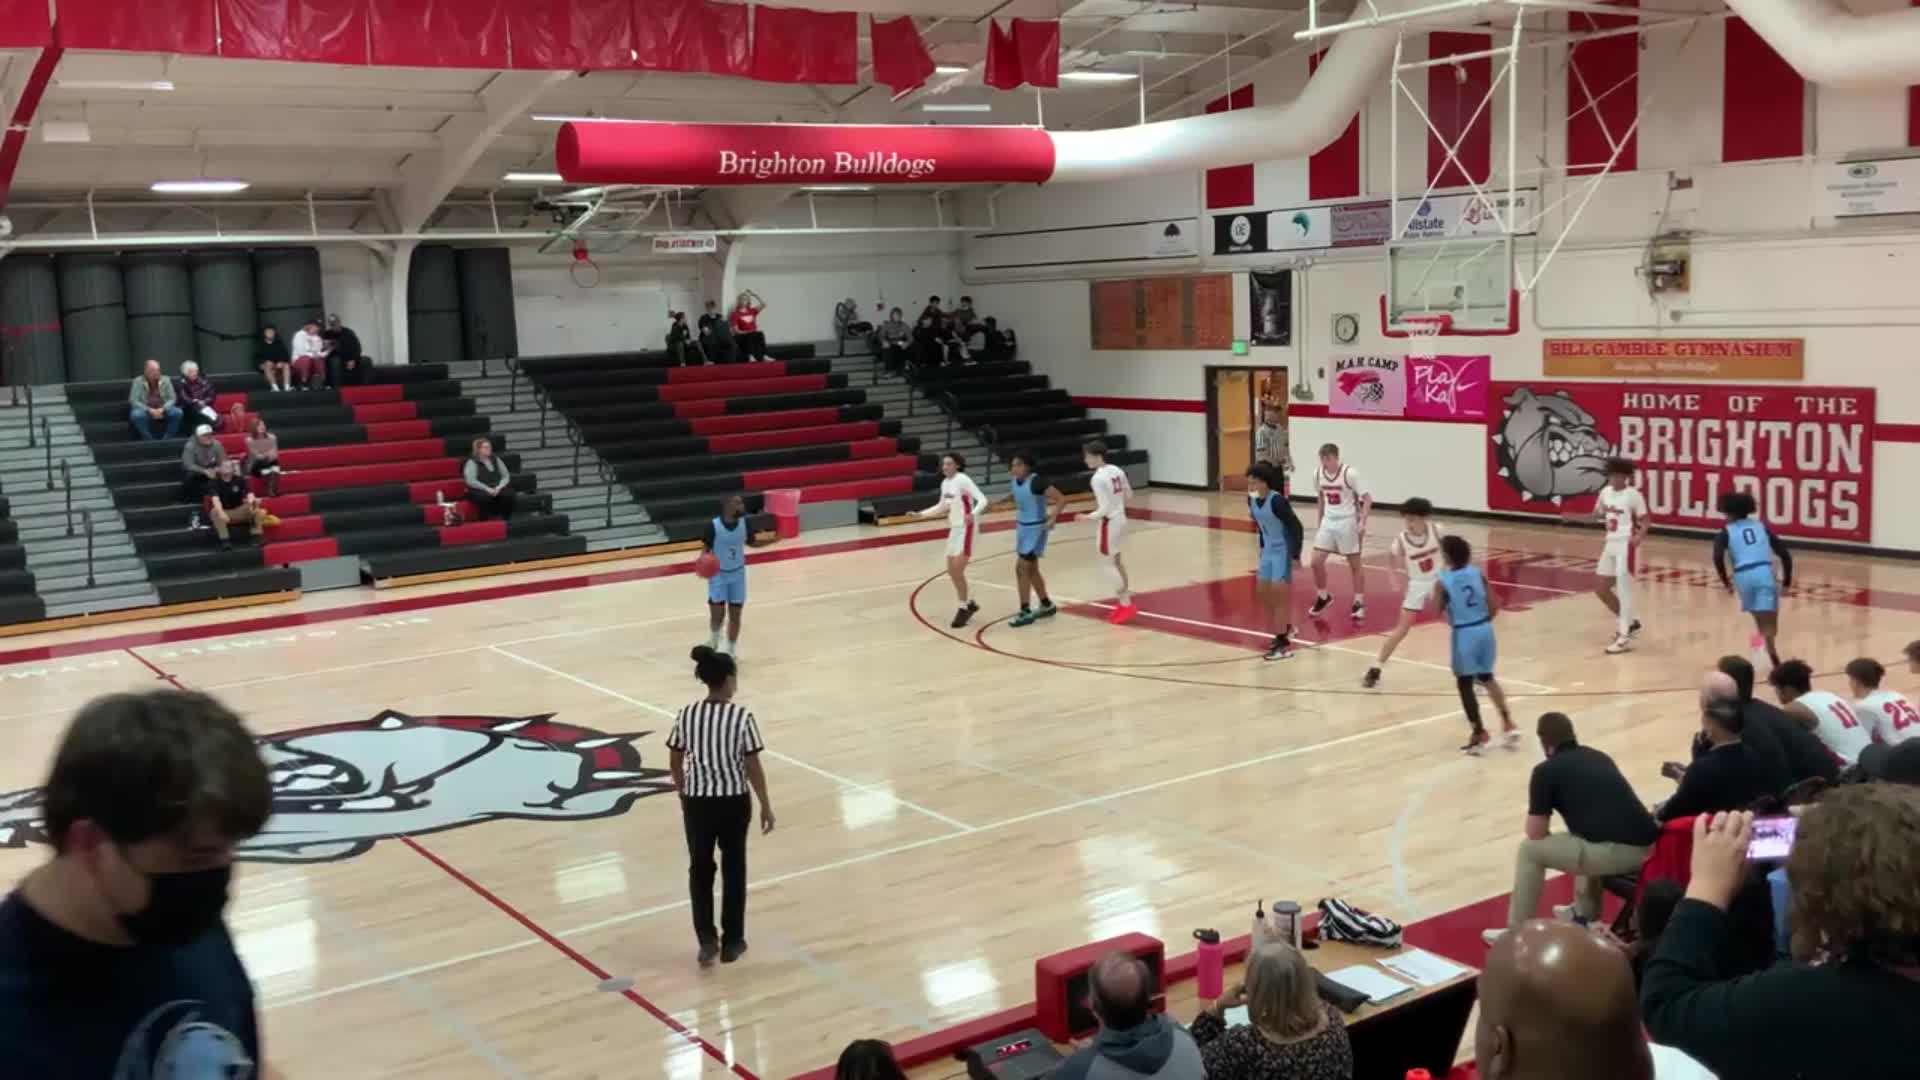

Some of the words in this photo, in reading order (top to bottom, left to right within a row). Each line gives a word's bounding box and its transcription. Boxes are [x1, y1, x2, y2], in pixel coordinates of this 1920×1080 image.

[719, 150, 826, 178] Brighton
[833, 151, 936, 178] Bulldogs
[1550, 342, 1587, 356] BILL
[1592, 342, 1666, 356] GAMBLE
[1674, 343, 1793, 357] GYMNASIUM
[1367, 356, 1399, 371] CAMP
[1623, 392, 1699, 410] HOME
[1727, 395, 1763, 413] OF
[1795, 397, 1857, 415] THE
[1618, 416, 1864, 473] BRIGHTON
[1743, 528, 1757, 545] 0
[1460, 585, 1478, 608] 2
[1828, 701, 1858, 729] 11
